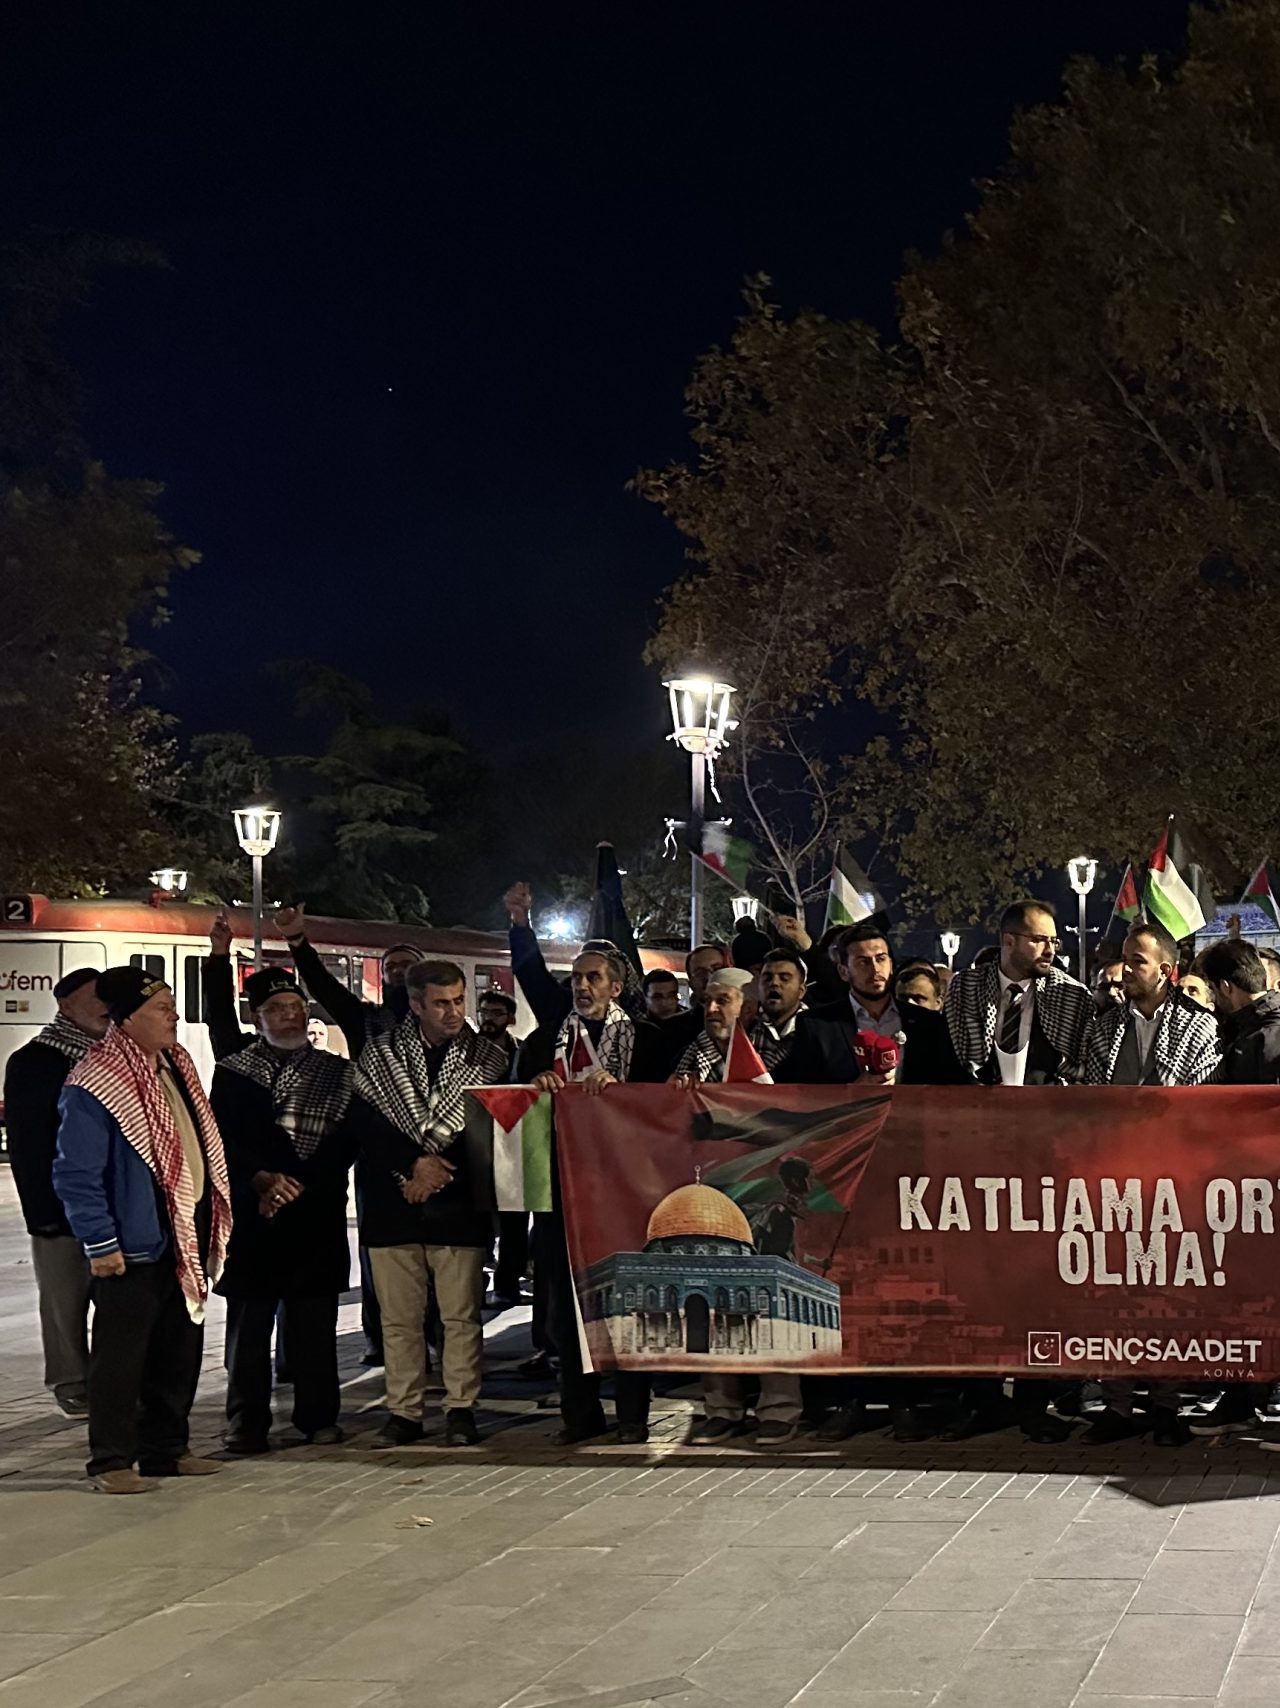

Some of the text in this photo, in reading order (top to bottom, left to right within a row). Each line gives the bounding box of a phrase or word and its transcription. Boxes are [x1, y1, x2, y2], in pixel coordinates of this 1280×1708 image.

[8, 901, 25, 920] 2
[1057, 1230, 1226, 1287] OLMA!
[1203, 1368, 1255, 1378] KONYA
